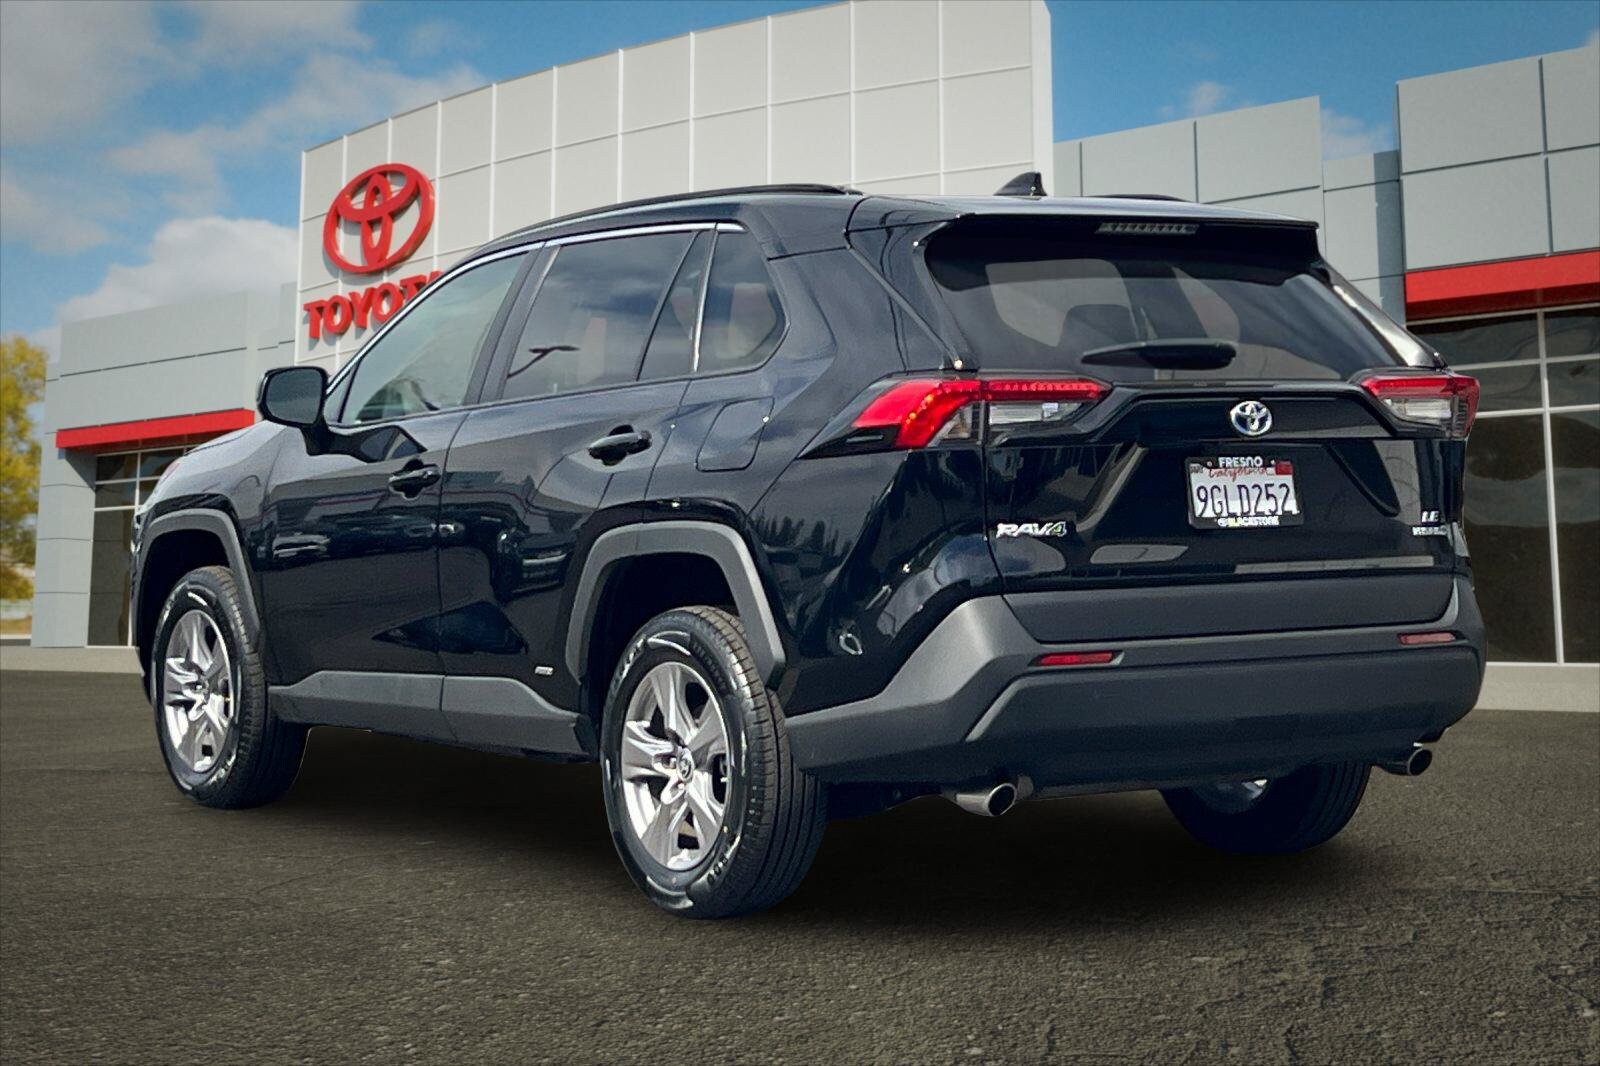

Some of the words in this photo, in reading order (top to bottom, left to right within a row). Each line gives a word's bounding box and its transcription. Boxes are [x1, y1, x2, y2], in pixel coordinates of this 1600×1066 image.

[303, 270, 444, 340] TOYOT
[1218, 456, 1263, 468] FRESNO
[1196, 483, 1294, 517] 9GLD252
[1421, 510, 1440, 523] LE
[995, 521, 1067, 539] RAV4
